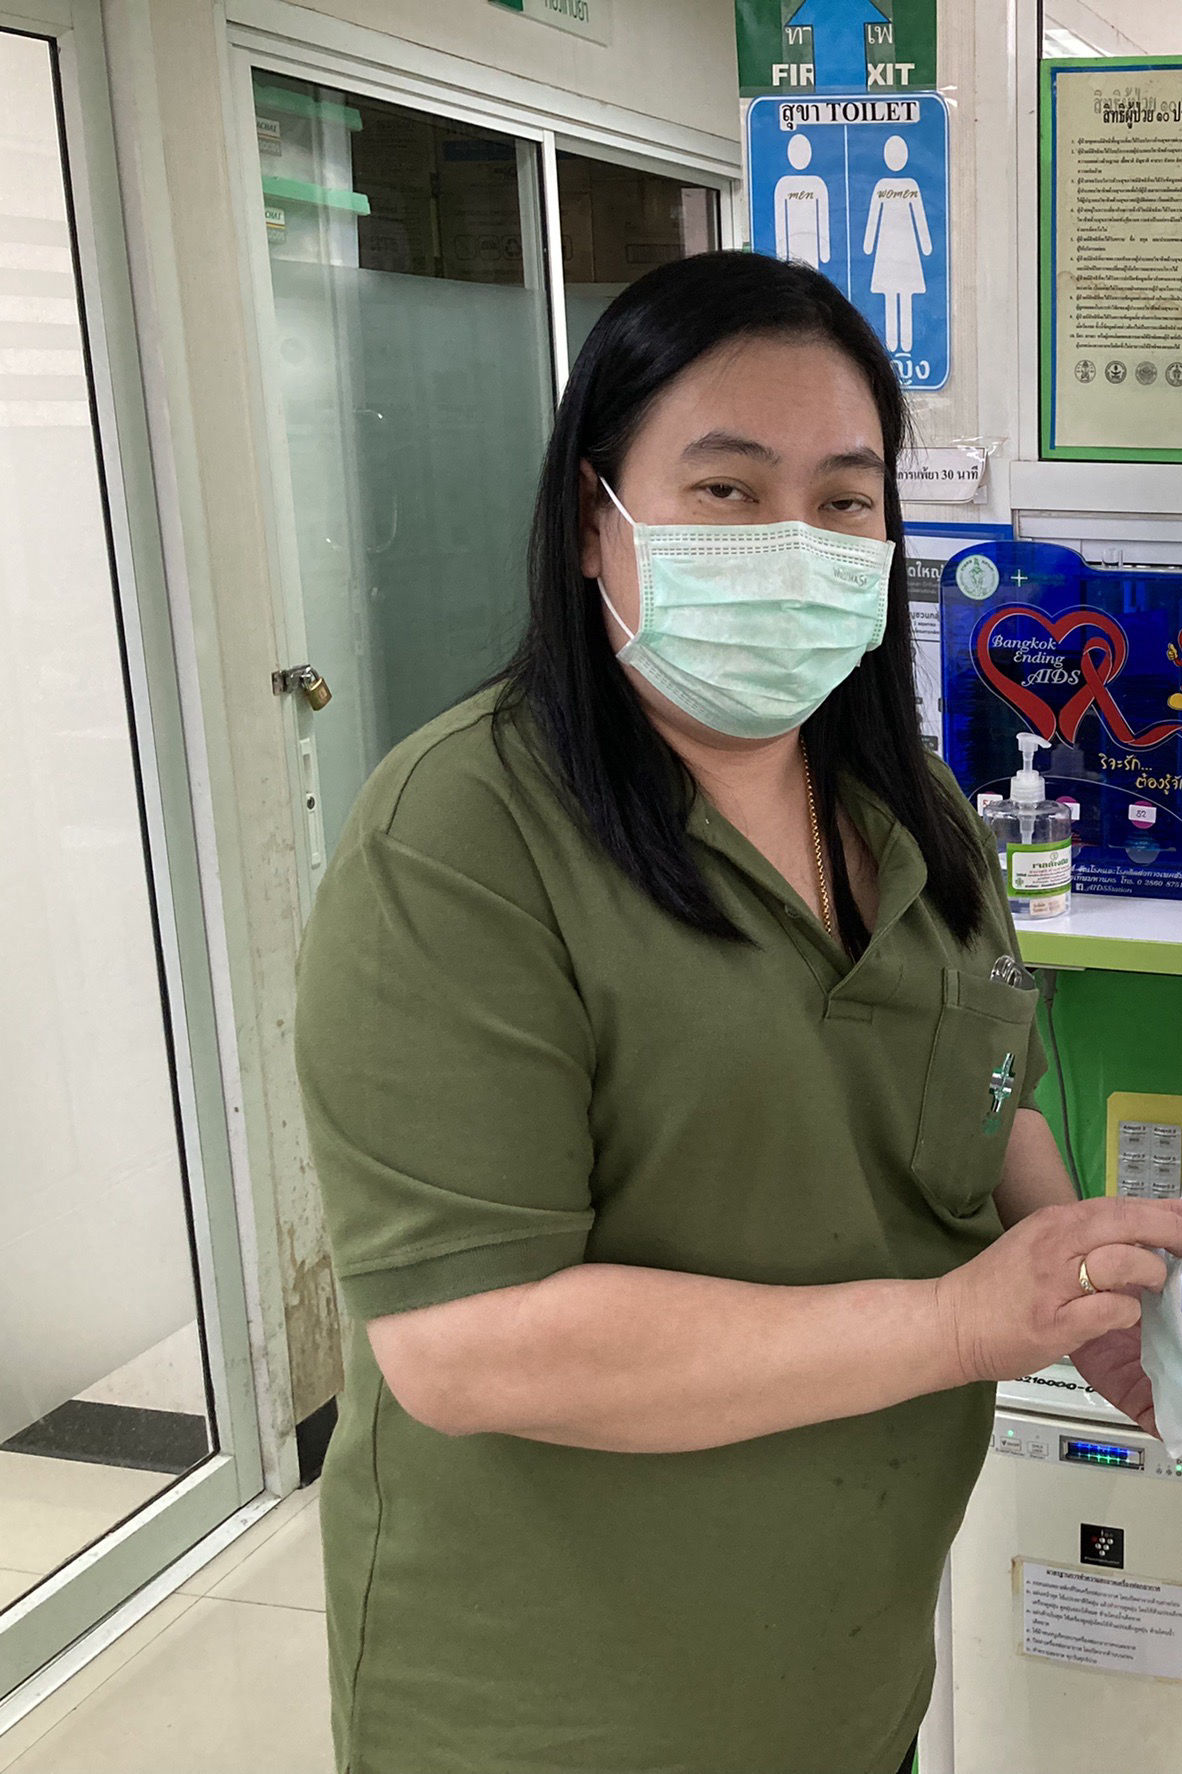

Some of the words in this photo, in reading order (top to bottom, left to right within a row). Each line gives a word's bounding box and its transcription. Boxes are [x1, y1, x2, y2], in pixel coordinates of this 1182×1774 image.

[772, 63, 814, 86] FIR
[867, 62, 915, 86] XIT
[782, 103, 819, 130] สุขา
[826, 101, 917, 121] TOILET
[1103, 102, 1154, 129] สิทธิผู้ป่วย
[942, 470, 954, 480] 30
[992, 634, 1056, 652] Bangkok
[1013, 651, 1065, 668] Ending
[1021, 668, 1081, 686] AIDS
